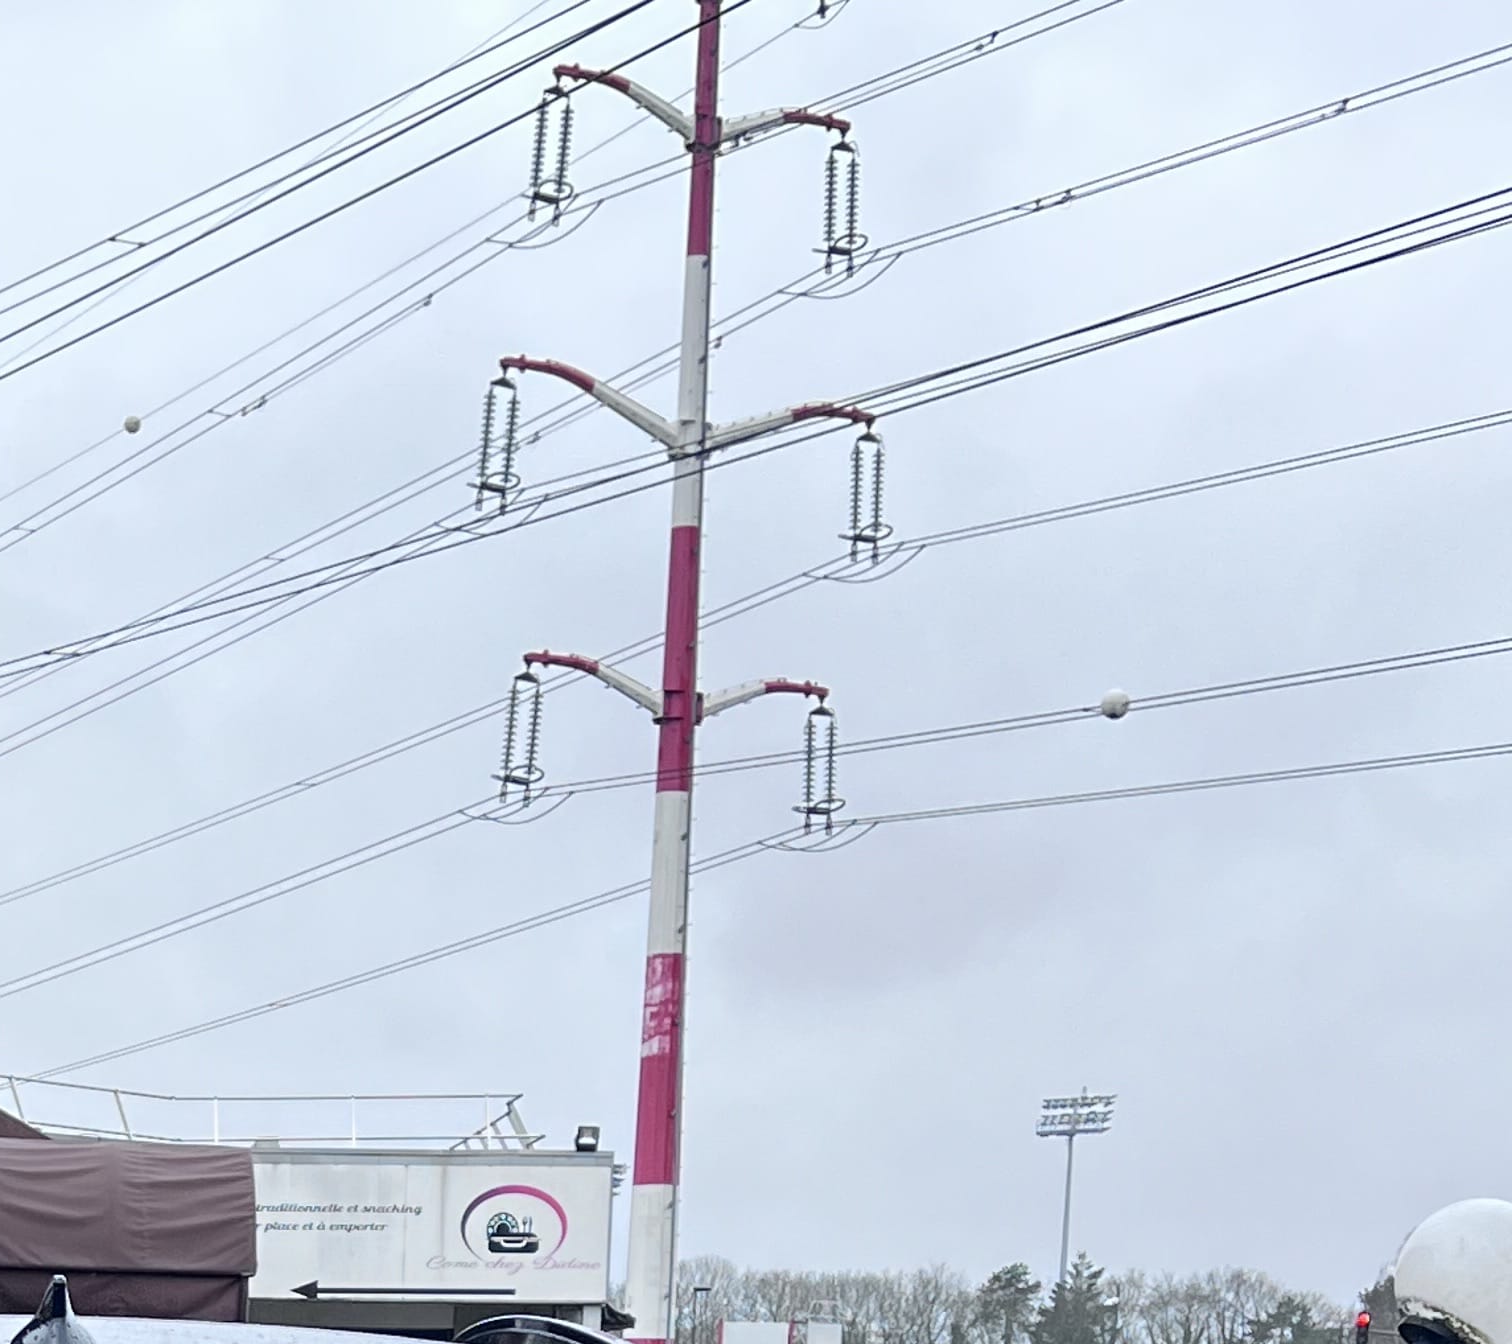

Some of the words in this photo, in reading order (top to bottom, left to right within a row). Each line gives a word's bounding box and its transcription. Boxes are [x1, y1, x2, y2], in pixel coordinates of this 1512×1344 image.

[255, 1202, 343, 1213] traditionnelle
[346, 1203, 358, 1213] et
[264, 1221, 298, 1233] place
[302, 1221, 313, 1231] et
[316, 1221, 326, 1231] à
[329, 1222, 388, 1233] emporter
[485, 1256, 523, 1276] chez
